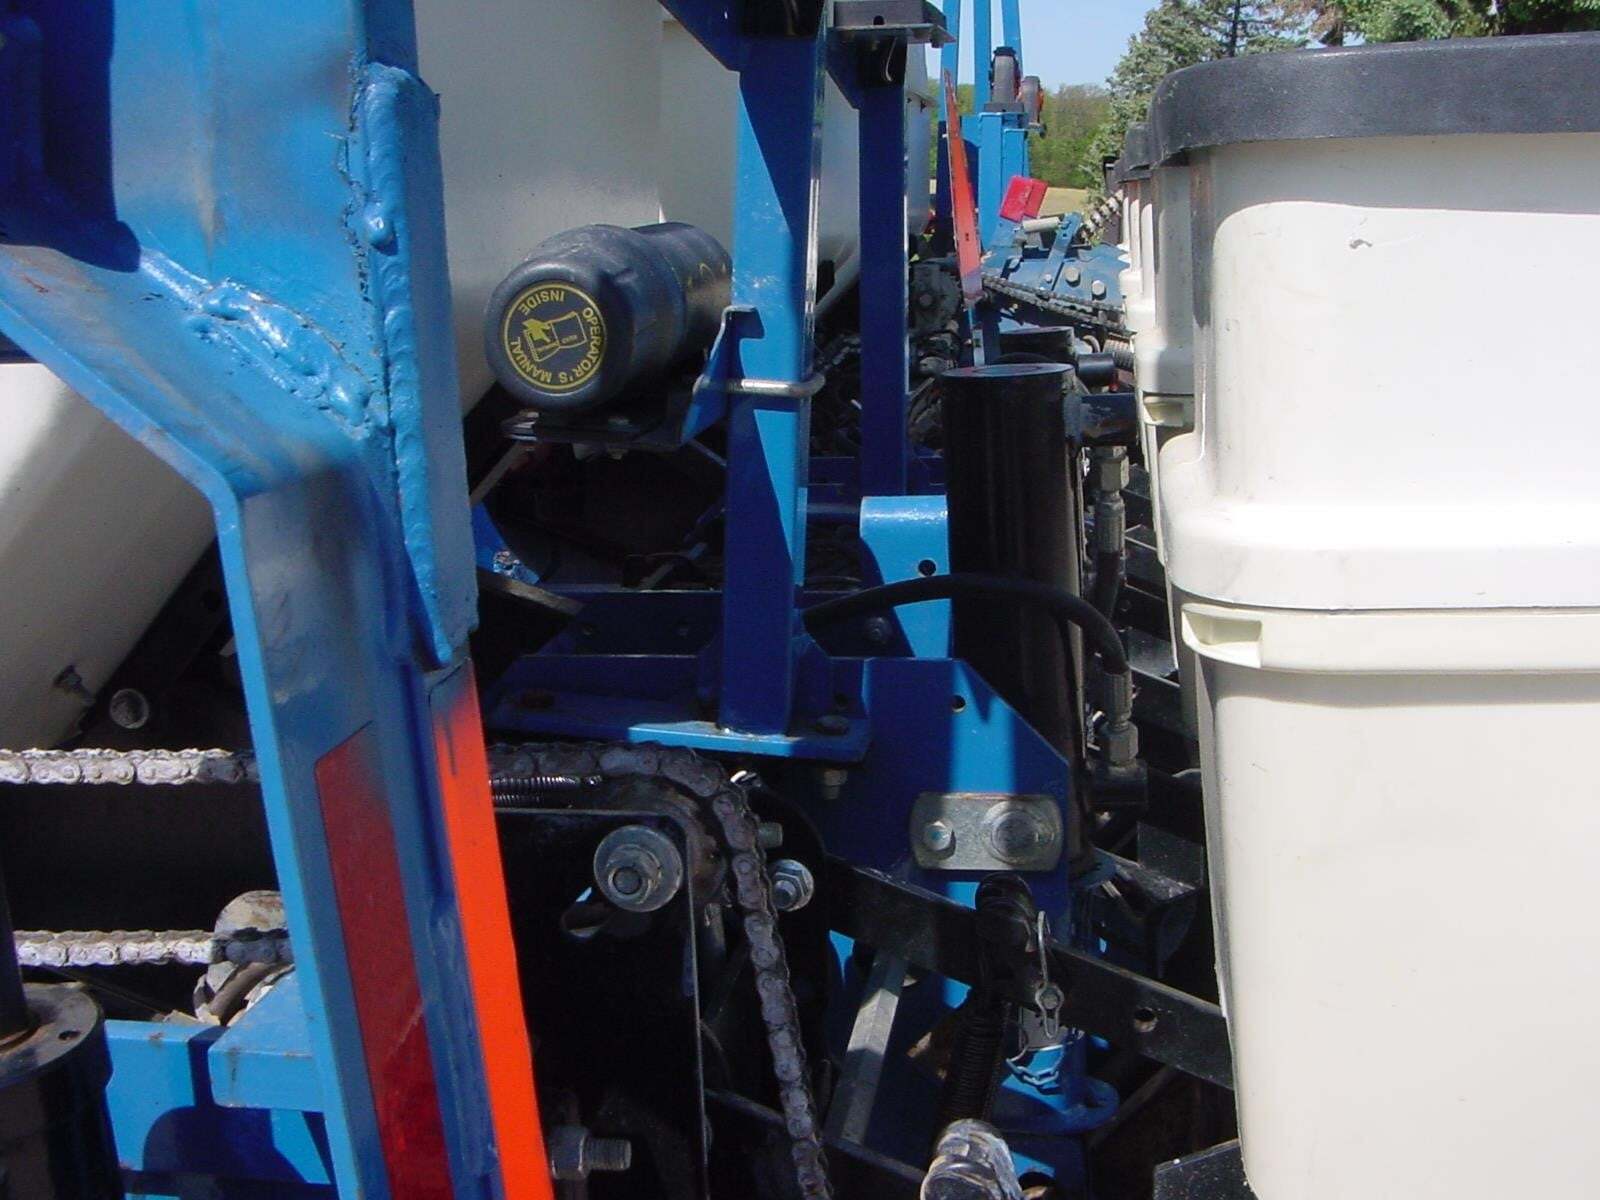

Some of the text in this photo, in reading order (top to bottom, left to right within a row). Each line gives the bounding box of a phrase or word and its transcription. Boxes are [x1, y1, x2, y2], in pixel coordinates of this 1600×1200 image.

[518, 290, 566, 316] INSIDE
[510, 307, 601, 383] OPERATOR'S MANUAL
